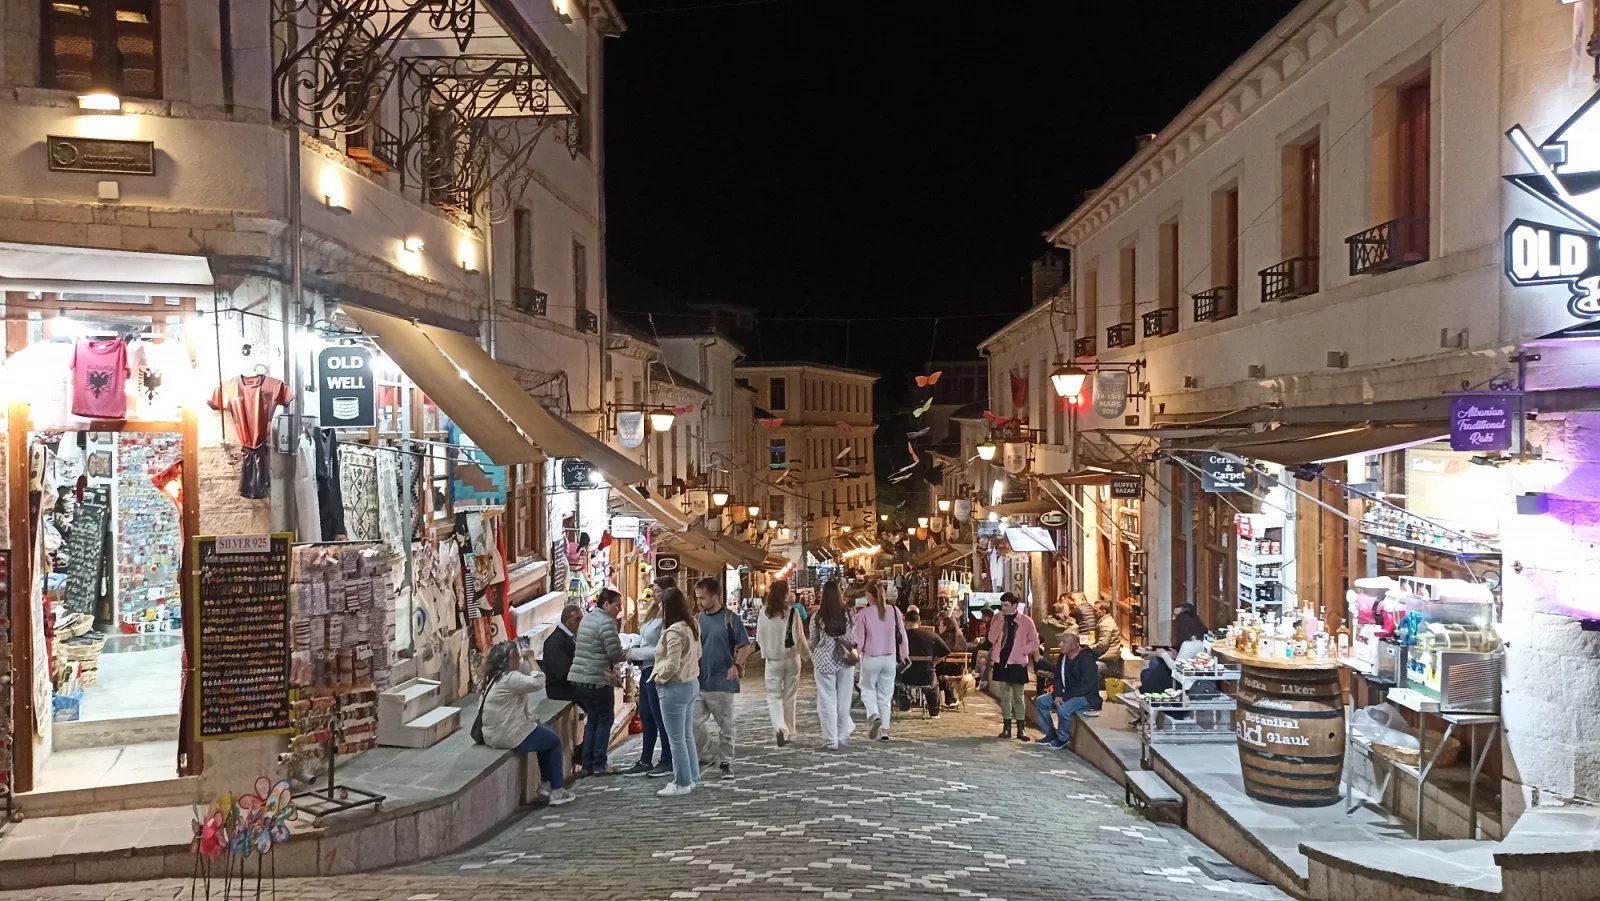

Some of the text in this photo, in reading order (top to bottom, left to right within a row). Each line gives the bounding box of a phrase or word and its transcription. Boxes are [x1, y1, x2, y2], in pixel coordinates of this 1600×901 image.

[1512, 225, 1588, 279] OLD
[327, 356, 364, 370] OLD
[327, 376, 366, 389] WELL
[1100, 400, 1122, 408] MARS
[1457, 406, 1504, 418] Albanian
[1457, 419, 1506, 431] Traditional
[1469, 432, 1495, 445] Raki
[1209, 455, 1250, 465] Ceraic
[1224, 464, 1234, 472] &
[1213, 471, 1246, 480] Carpet
[219, 537, 268, 550] SILVER 925
[1244, 678, 1317, 695] Vodka Liker
[1246, 712, 1299, 728] Botanikal
[1236, 720, 1310, 747] aki Glauk
